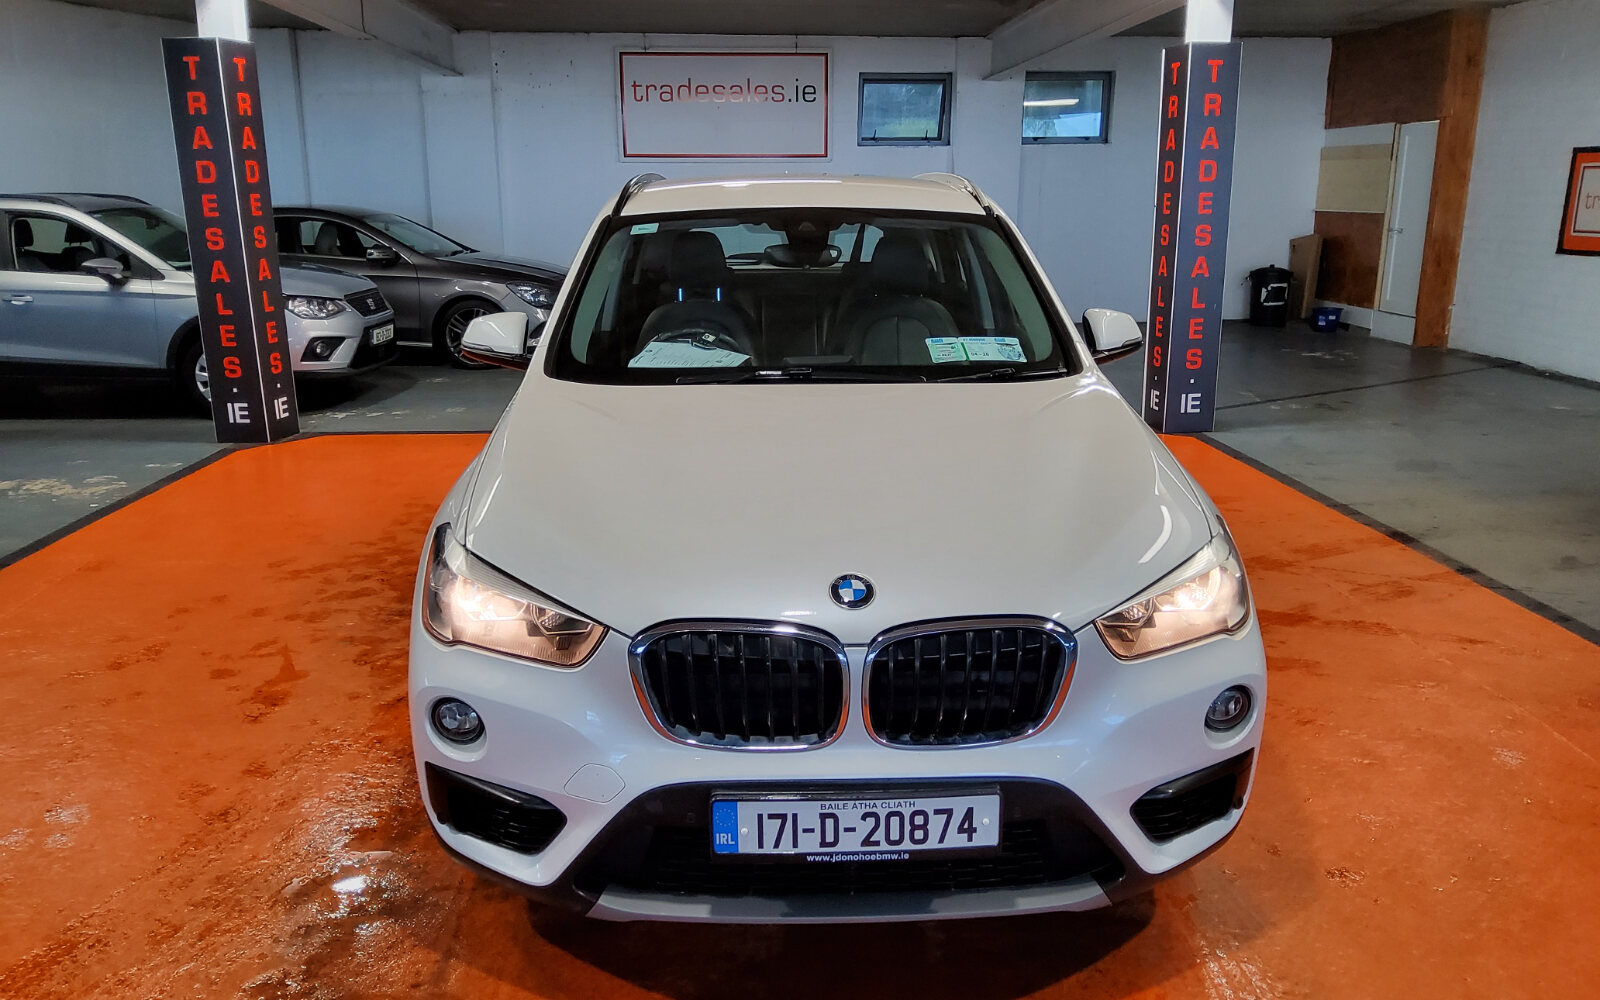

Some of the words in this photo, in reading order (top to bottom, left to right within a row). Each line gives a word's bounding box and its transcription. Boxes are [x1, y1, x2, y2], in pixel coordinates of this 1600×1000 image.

[631, 77, 817, 103] tradesales.ie
[820, 802, 849, 811] BAILE
[880, 800, 916, 809] CLIATH
[757, 806, 978, 850] 171-D-20874
[715, 833, 735, 845] IRL
[806, 852, 910, 863] www.jdonohoebmw.ie
